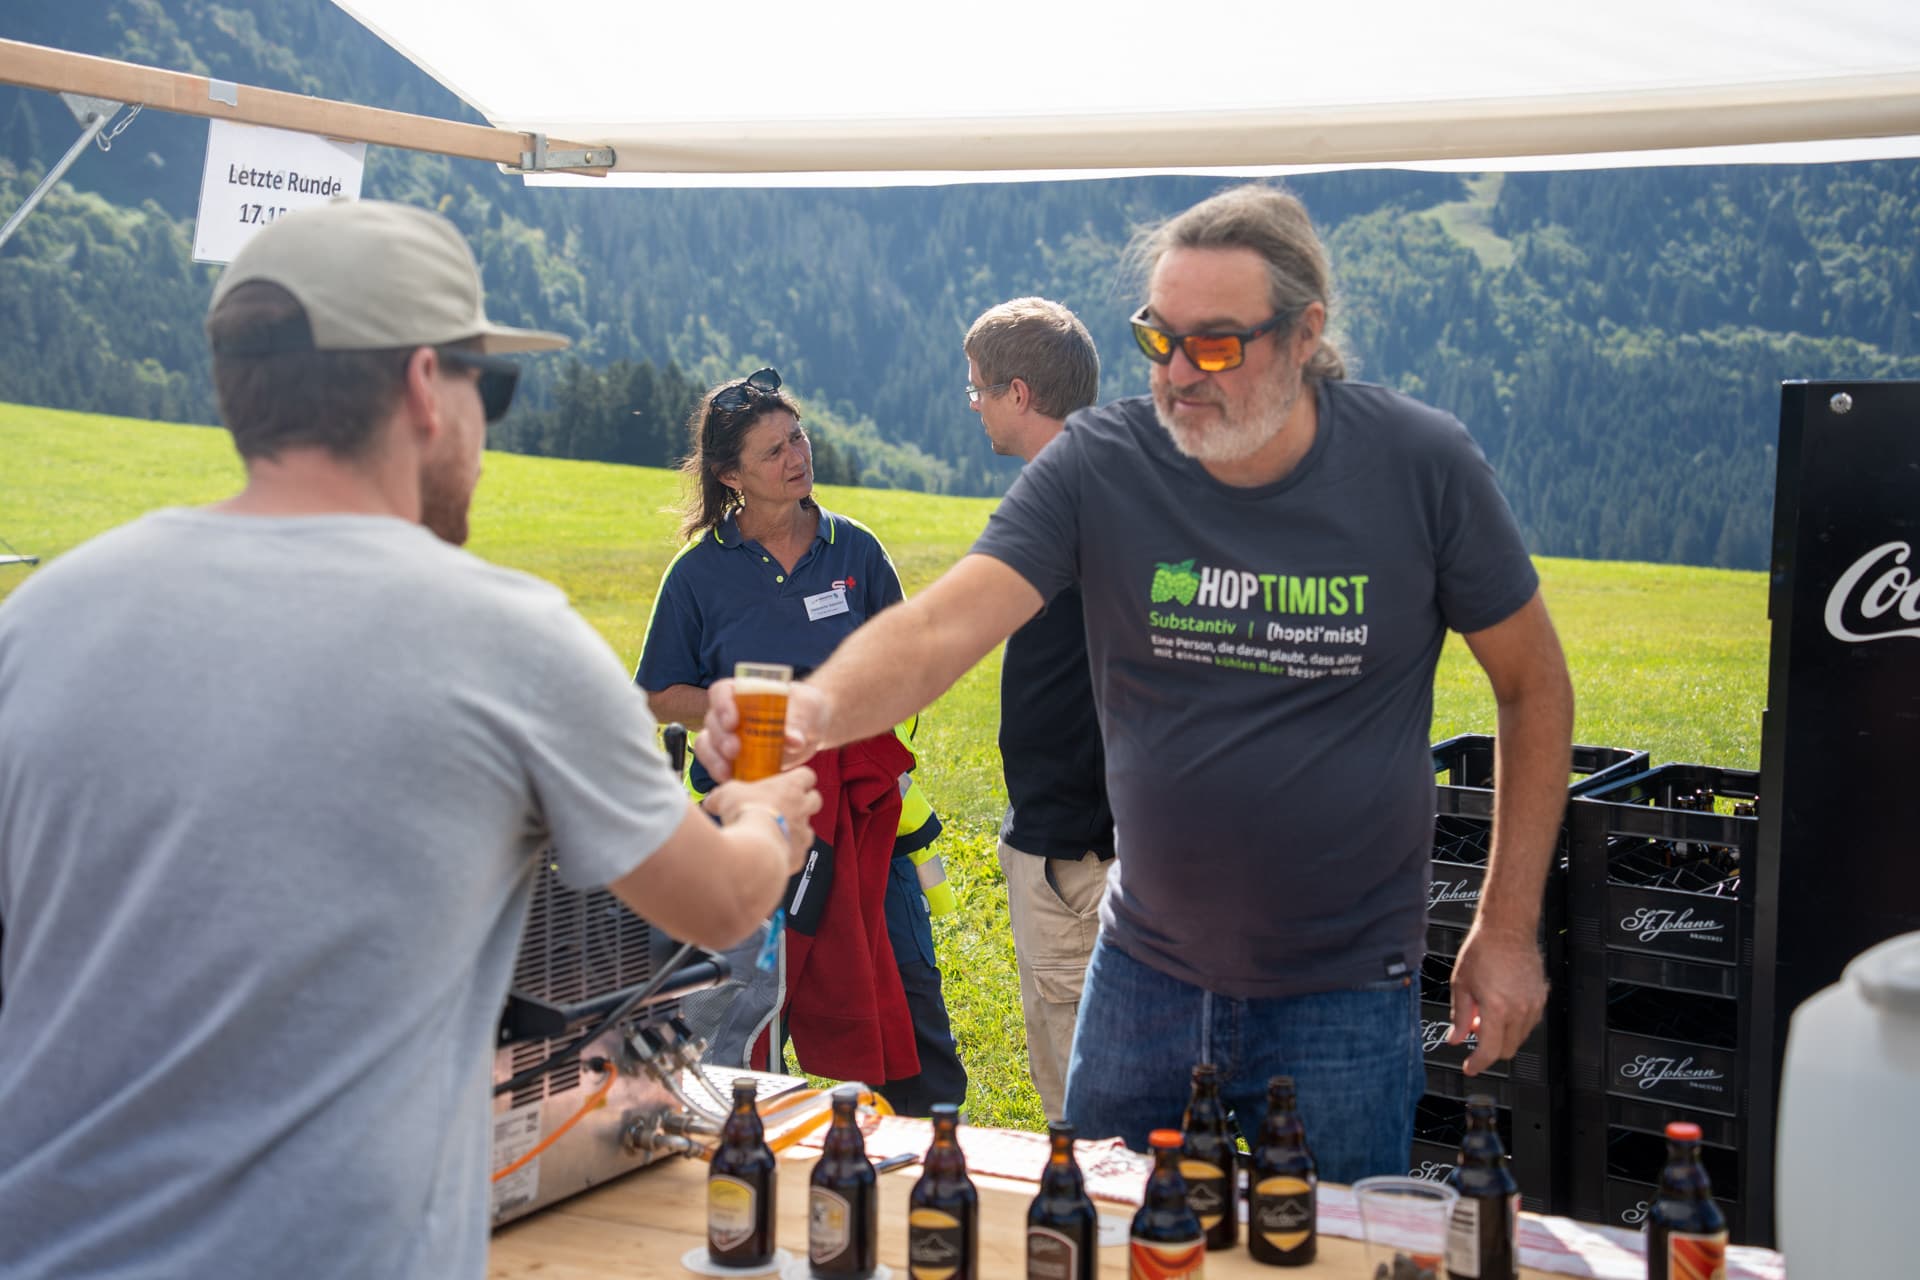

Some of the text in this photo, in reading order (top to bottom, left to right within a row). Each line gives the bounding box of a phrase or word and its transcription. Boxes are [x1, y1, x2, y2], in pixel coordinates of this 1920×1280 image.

[229, 163, 342, 197] Letzte Runde
[1197, 566, 1369, 615] HOPTIMIST
[1149, 611, 1236, 635] Substantiv
[1151, 634, 1362, 667] Eine Person, die daran glaubt, dass alles
[1153, 646, 1174, 659] mit
[1175, 649, 1213, 664] einem
[1258, 660, 1285, 674] Bier
[1287, 664, 1328, 679] besser
[1330, 664, 1362, 677] wird.
